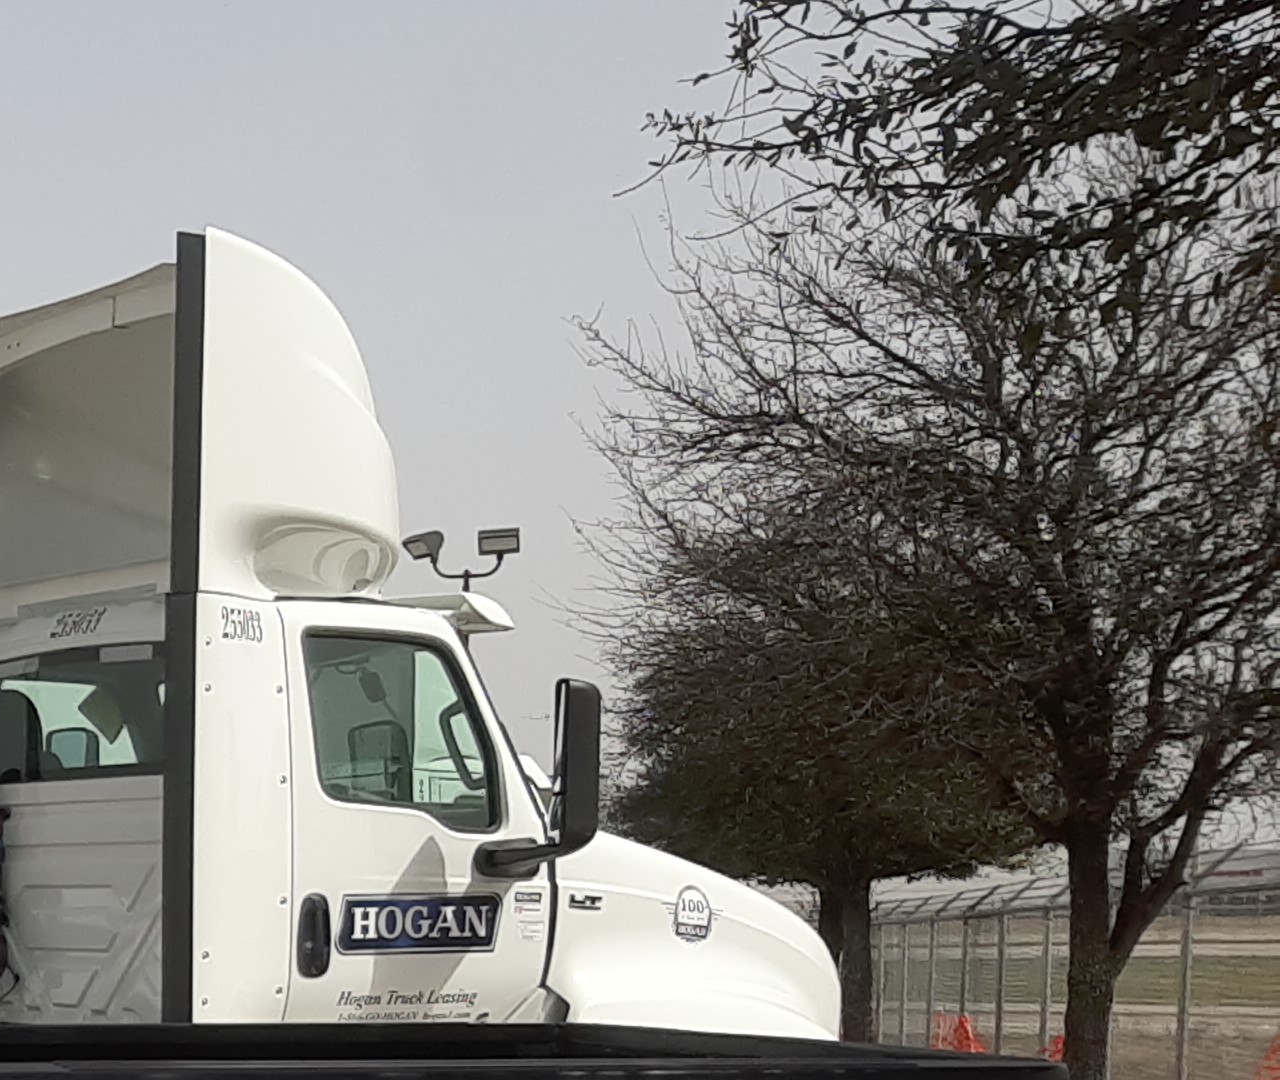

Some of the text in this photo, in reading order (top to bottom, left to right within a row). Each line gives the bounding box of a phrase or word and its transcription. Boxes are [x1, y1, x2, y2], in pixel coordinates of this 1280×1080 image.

[681, 898, 705, 914] 100
[351, 905, 490, 940] HOGAN
[336, 988, 478, 1010] Hogan Truck Leasing
